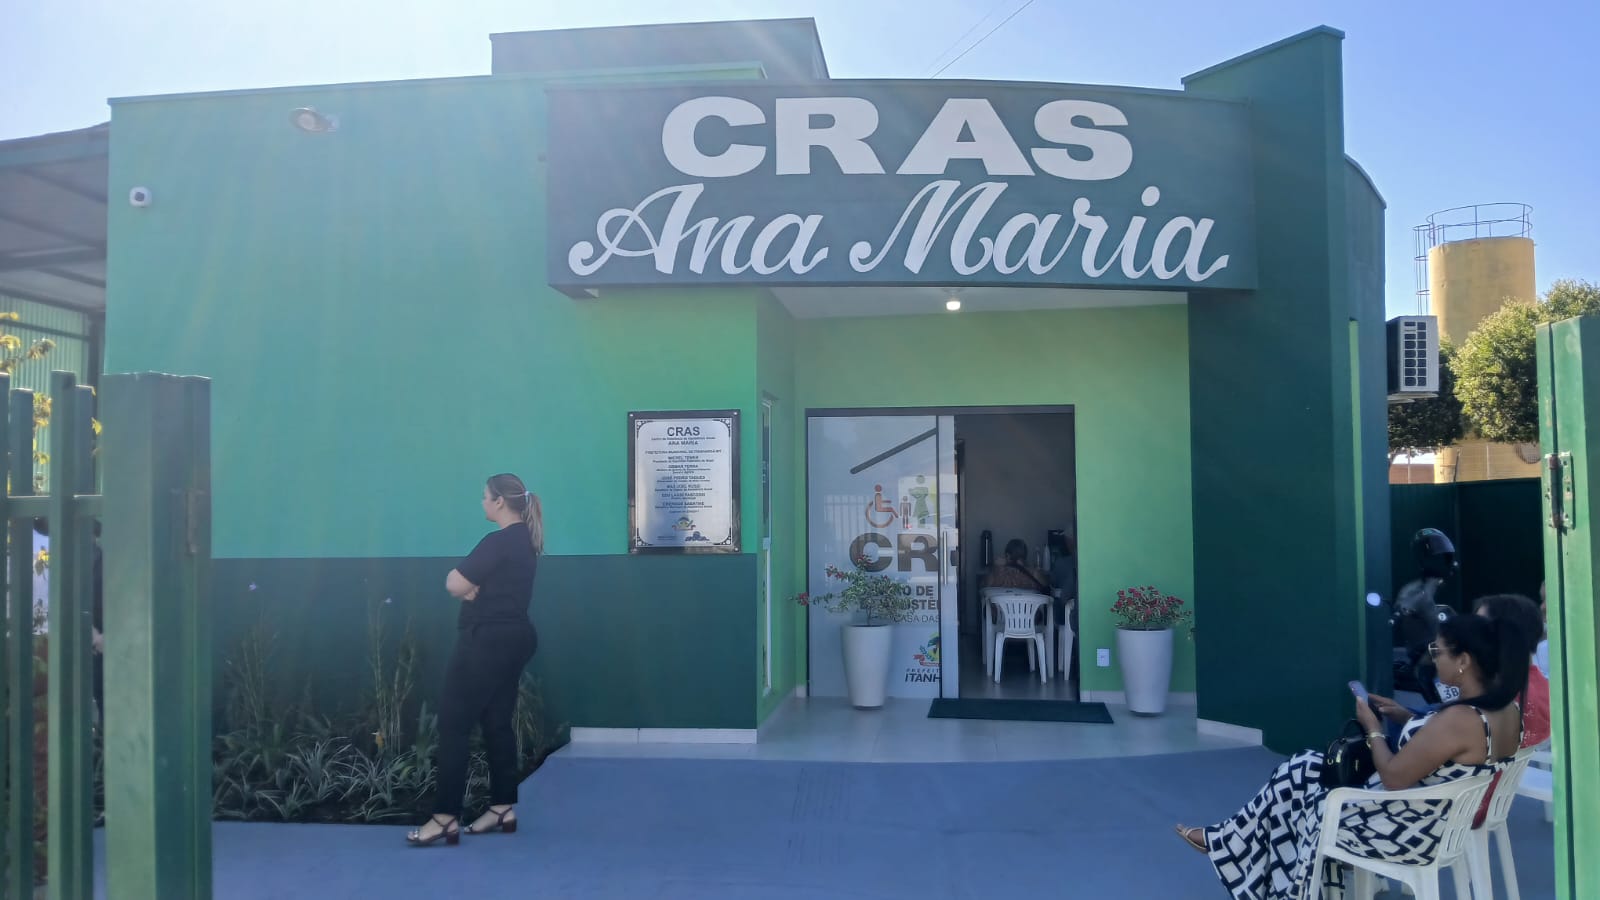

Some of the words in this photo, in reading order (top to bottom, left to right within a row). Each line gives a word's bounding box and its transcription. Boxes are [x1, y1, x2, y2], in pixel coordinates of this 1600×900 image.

[662, 96, 1133, 180] CRAS
[568, 183, 829, 276] Ana
[849, 179, 1230, 282] Maria
[667, 426, 700, 437] CRAS
[916, 585, 934, 596] DE
